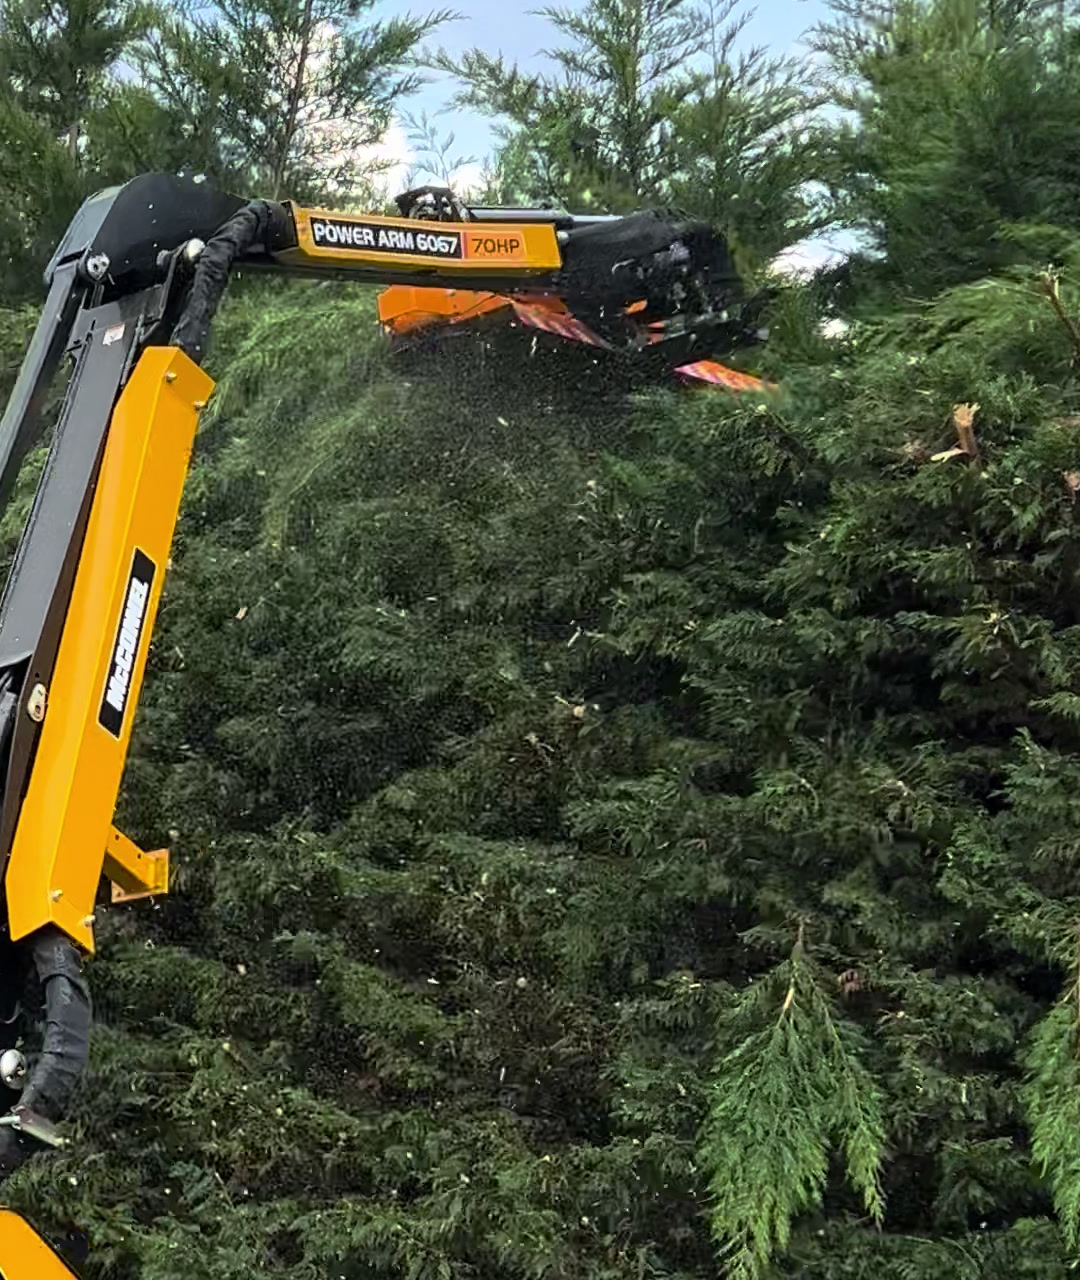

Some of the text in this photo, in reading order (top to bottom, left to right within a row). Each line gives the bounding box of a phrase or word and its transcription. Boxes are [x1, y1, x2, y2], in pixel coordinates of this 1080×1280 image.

[314, 223, 520, 254] POWER ARM 6067 70HP
[106, 577, 149, 712] McCONNEL
